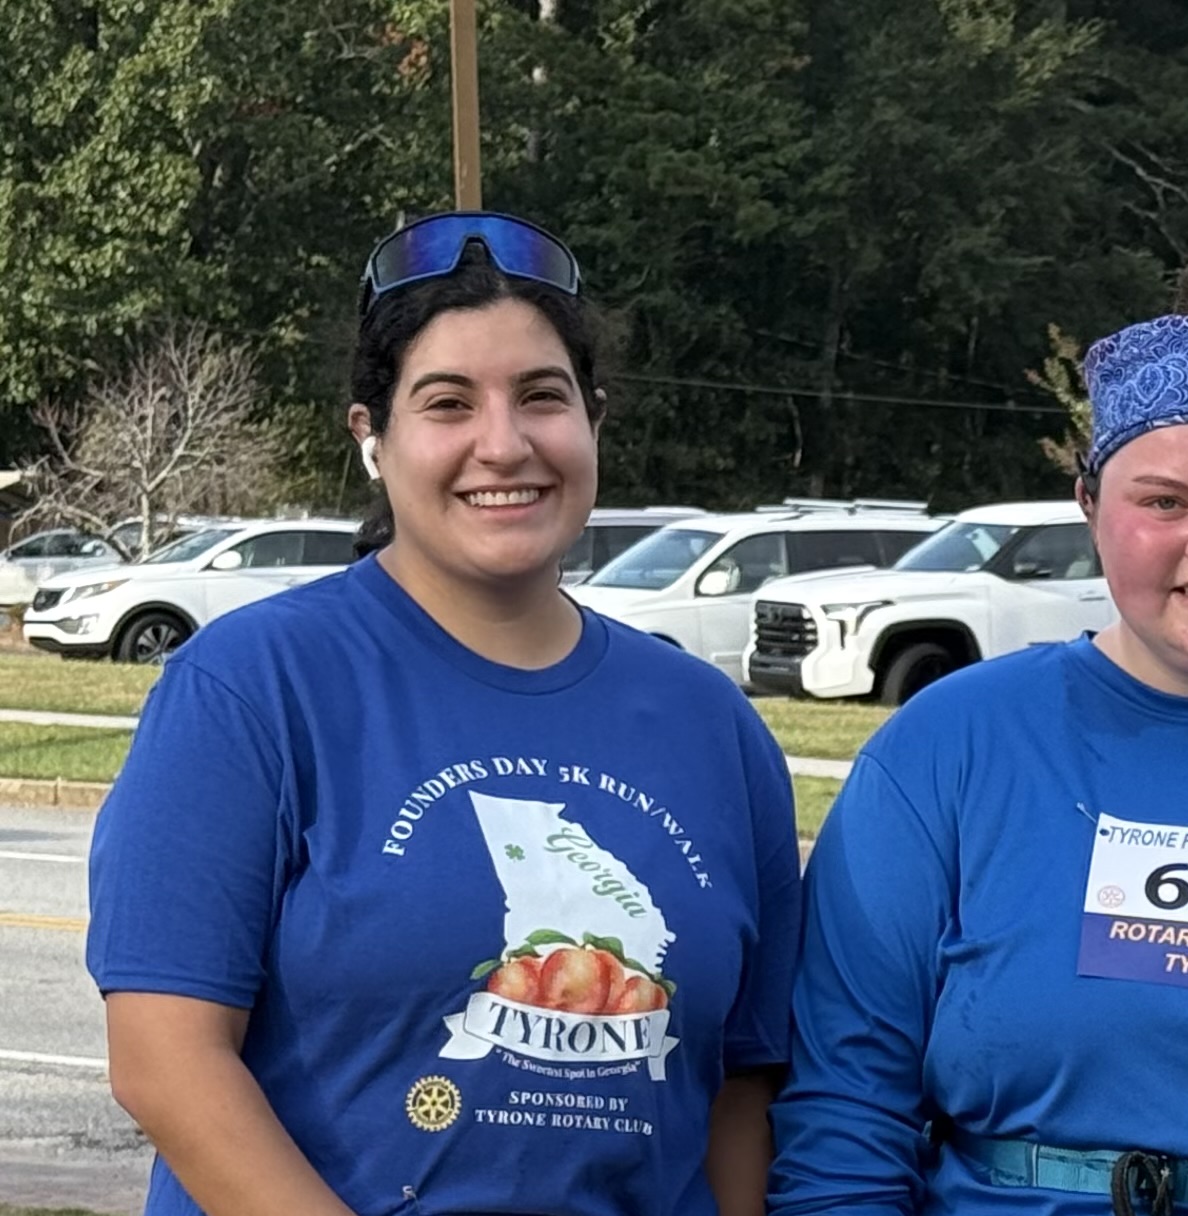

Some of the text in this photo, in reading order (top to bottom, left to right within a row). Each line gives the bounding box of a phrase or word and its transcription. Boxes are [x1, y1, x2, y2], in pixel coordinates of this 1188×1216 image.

[382, 758, 488, 857] FOUNDERS
[491, 756, 547, 776] DAY
[559, 766, 590, 785] 5K
[1108, 826, 1178, 848] TYRONE
[543, 827, 648, 919] Georgia
[489, 1002, 652, 1054] TYRONE
[509, 1090, 628, 1112] SPONSORED BY
[475, 1108, 653, 1136] TYRONE ROTARY CLUB
